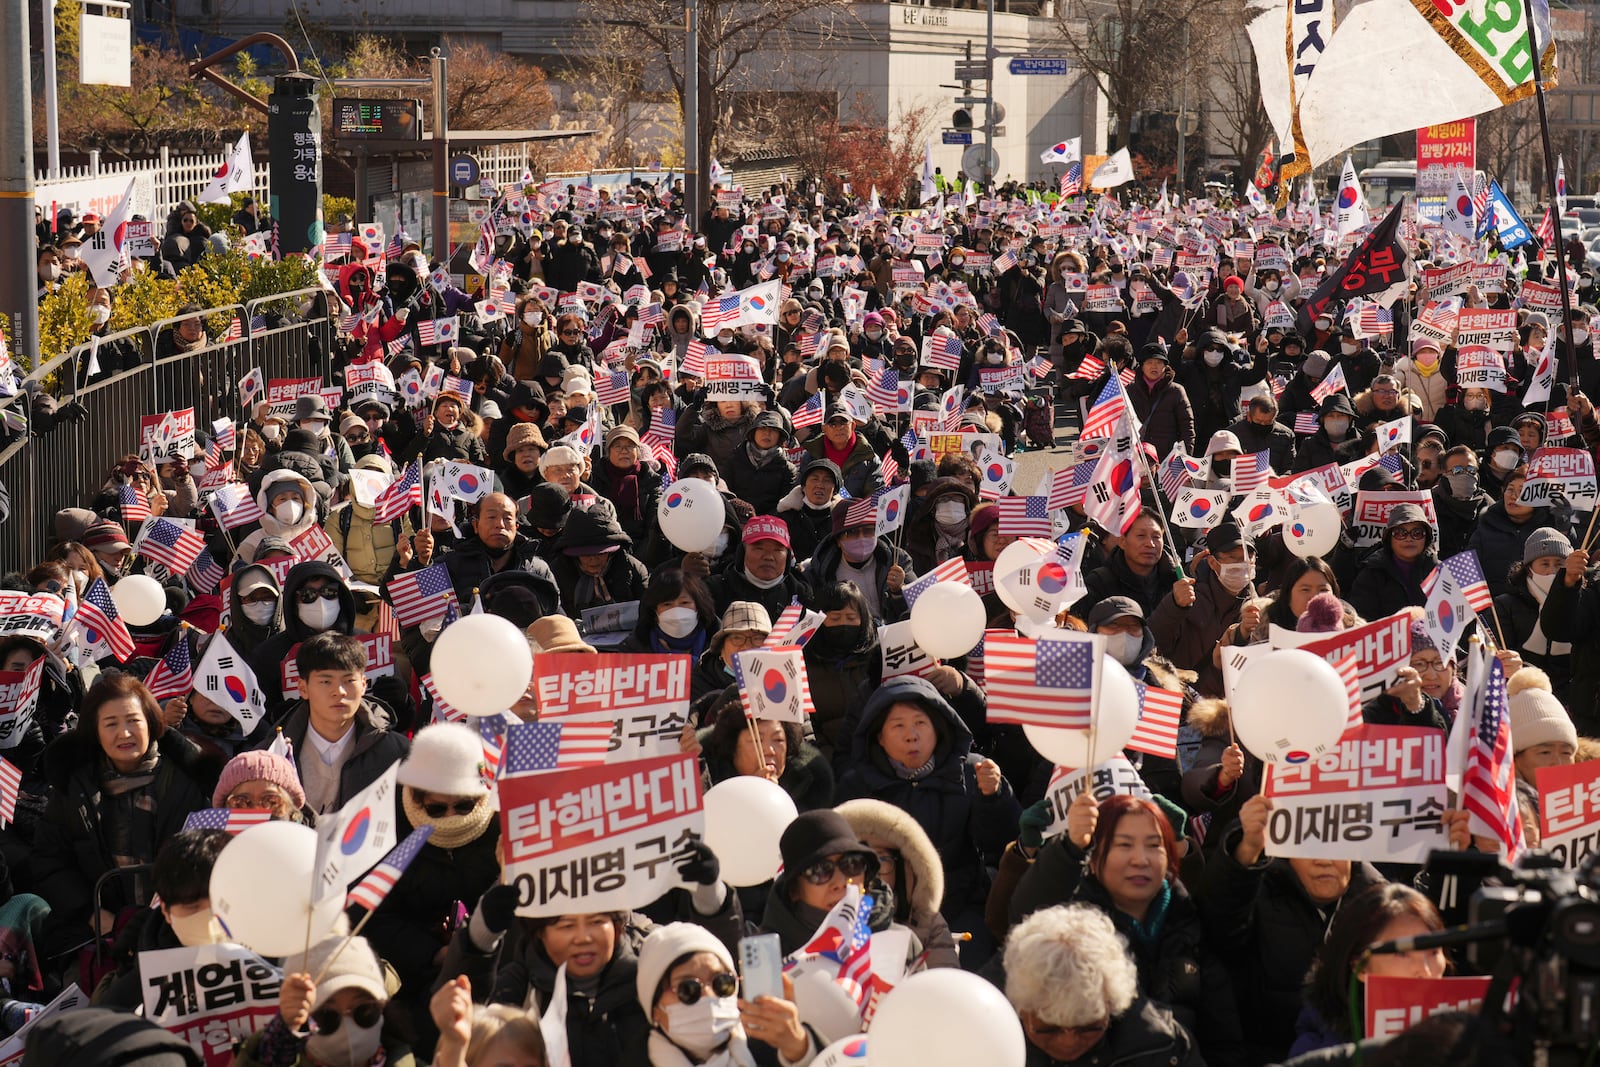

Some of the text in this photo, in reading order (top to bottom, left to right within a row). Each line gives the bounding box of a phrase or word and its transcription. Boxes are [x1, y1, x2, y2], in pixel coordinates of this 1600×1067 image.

[293, 164, 318, 182] 용산
[129, 223, 151, 238] 반대
[1428, 264, 1473, 287] 탄핵반대
[1412, 323, 1446, 340] 이재명
[1459, 311, 1518, 331] 탄핵반대
[1458, 331, 1515, 346] 이재명 구속
[707, 382, 740, 395] 이재명
[931, 435, 963, 452] 내란
[1526, 453, 1594, 478] 탄핵반대
[1520, 481, 1597, 503] 이재명 구속
[538, 659, 688, 714] 탄핵반대
[628, 712, 686, 748] 구속
[1270, 736, 1443, 793] 탄핵반대
[507, 758, 699, 860] 탄핵반대
[1269, 796, 1446, 846] 이재명 구속
[516, 846, 626, 908] 이재명
